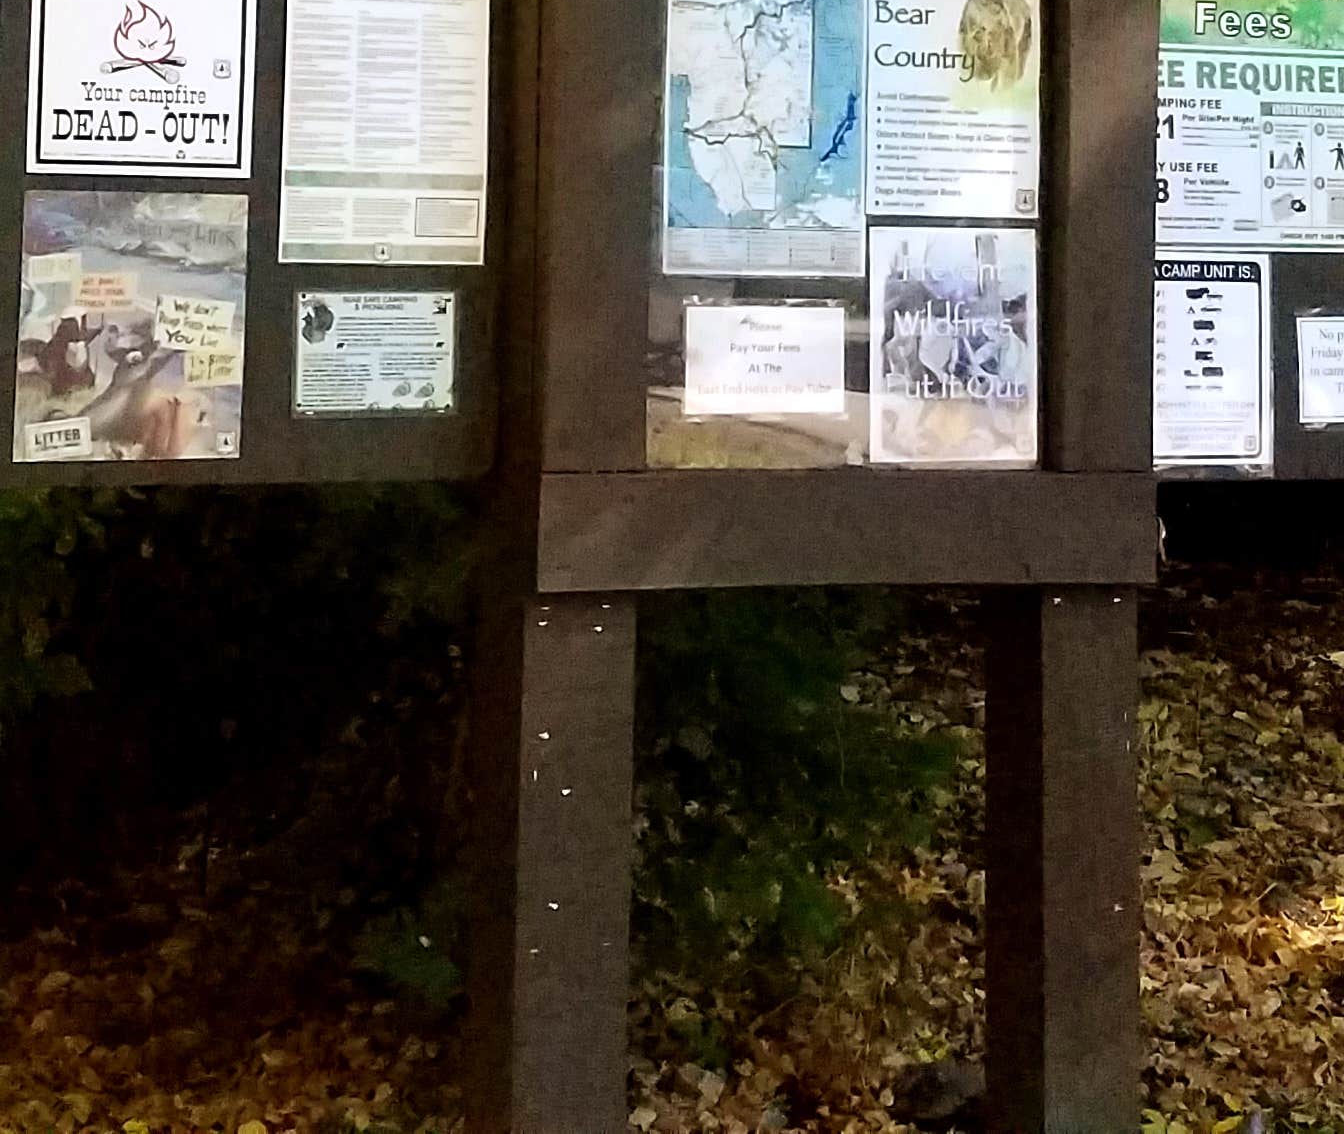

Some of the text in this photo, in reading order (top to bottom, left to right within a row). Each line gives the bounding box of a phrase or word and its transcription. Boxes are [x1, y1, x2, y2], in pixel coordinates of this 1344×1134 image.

[875, 0, 935, 24] Bear
[1195, 1, 1293, 39] Fees
[874, 44, 975, 82] Country
[81, 82, 206, 109] Your campfire
[1200, 99, 1222, 109] FEE
[1170, 163, 1193, 172] USE
[1197, 163, 1218, 173] FEE
[1161, 264, 1200, 277] CAMP
[1204, 265, 1235, 278] UNIT
[894, 300, 1013, 337] Wildfires
[1319, 329, 1334, 339] No
[730, 343, 748, 354] Pay
[751, 343, 774, 352] Your
[1311, 347, 1343, 360] Friday
[763, 364, 782, 373] The
[886, 373, 935, 398] Put
[967, 373, 1025, 398] Out
[35, 429, 81, 447] LITTER
